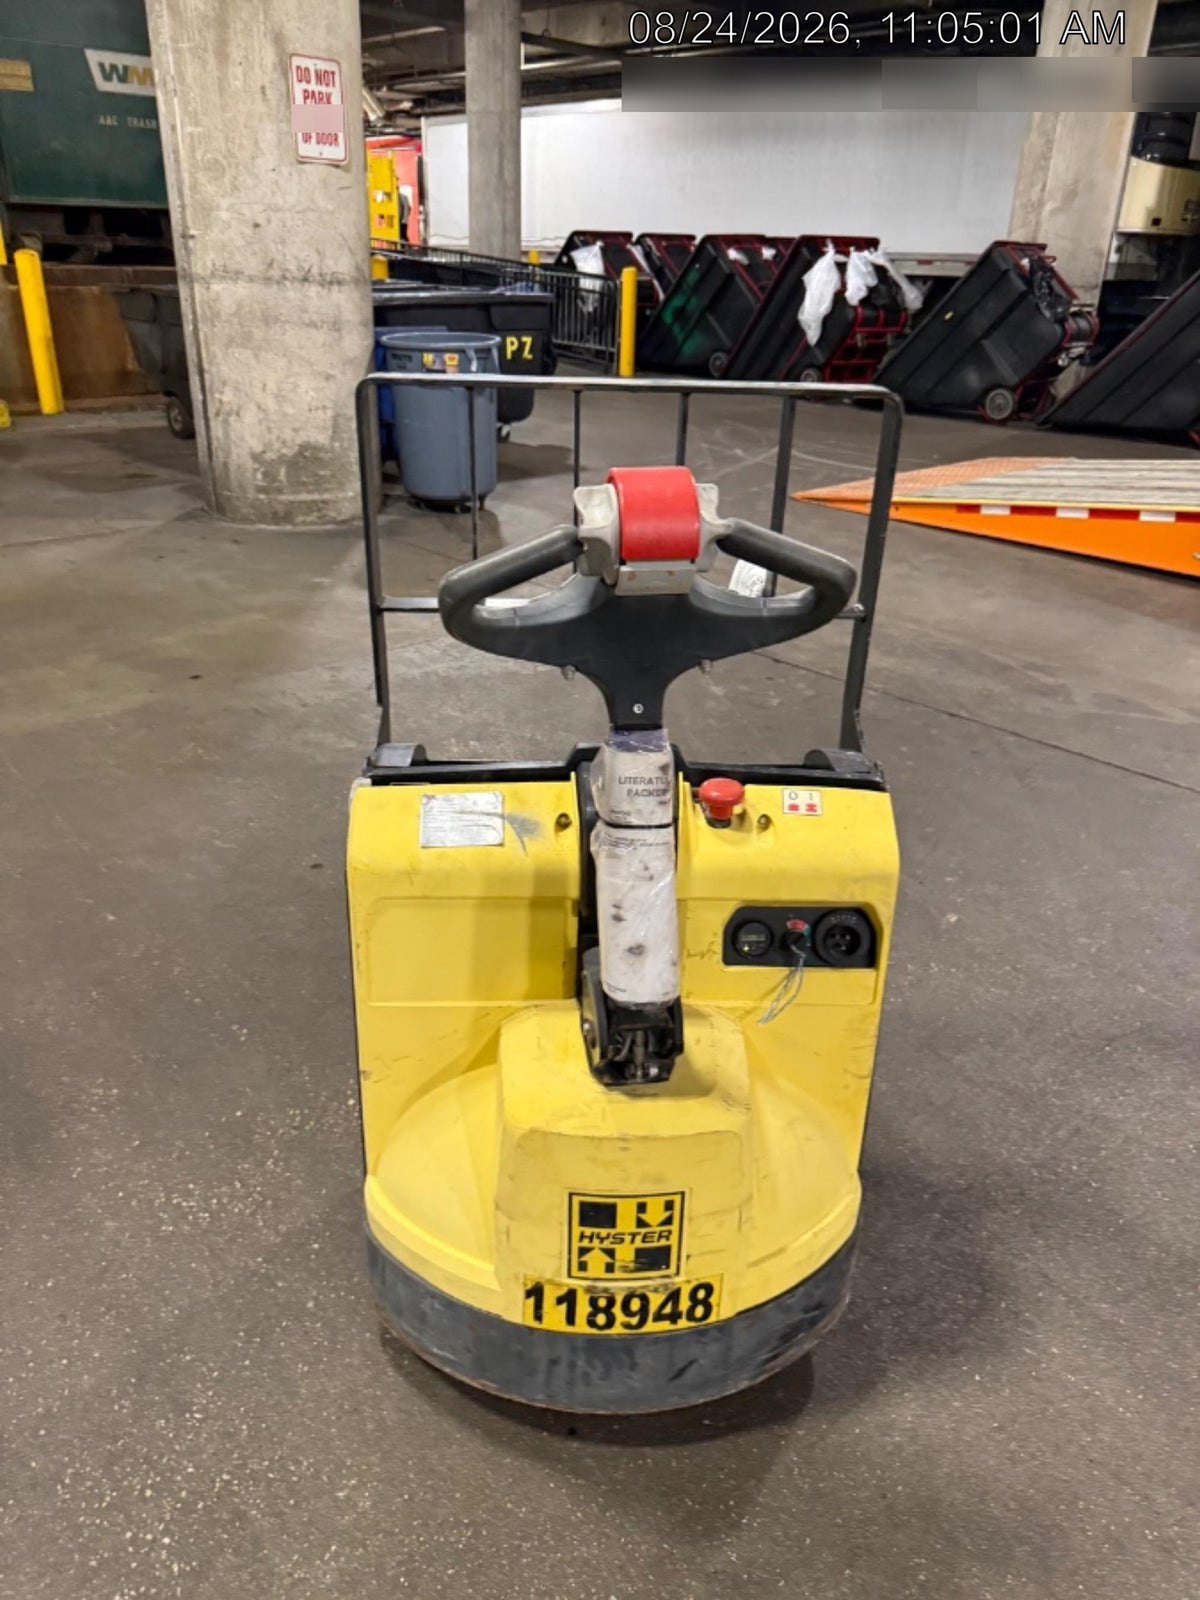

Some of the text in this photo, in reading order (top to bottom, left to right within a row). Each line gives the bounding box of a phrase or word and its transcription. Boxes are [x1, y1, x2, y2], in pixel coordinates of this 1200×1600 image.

[97, 61, 155, 87] WM
[295, 65, 336, 88] DO NOT
[302, 88, 333, 105] PARK
[618, 776, 667, 785] LITERATU
[578, 1229, 672, 1246] HYSTER
[524, 1282, 714, 1331] 118948
